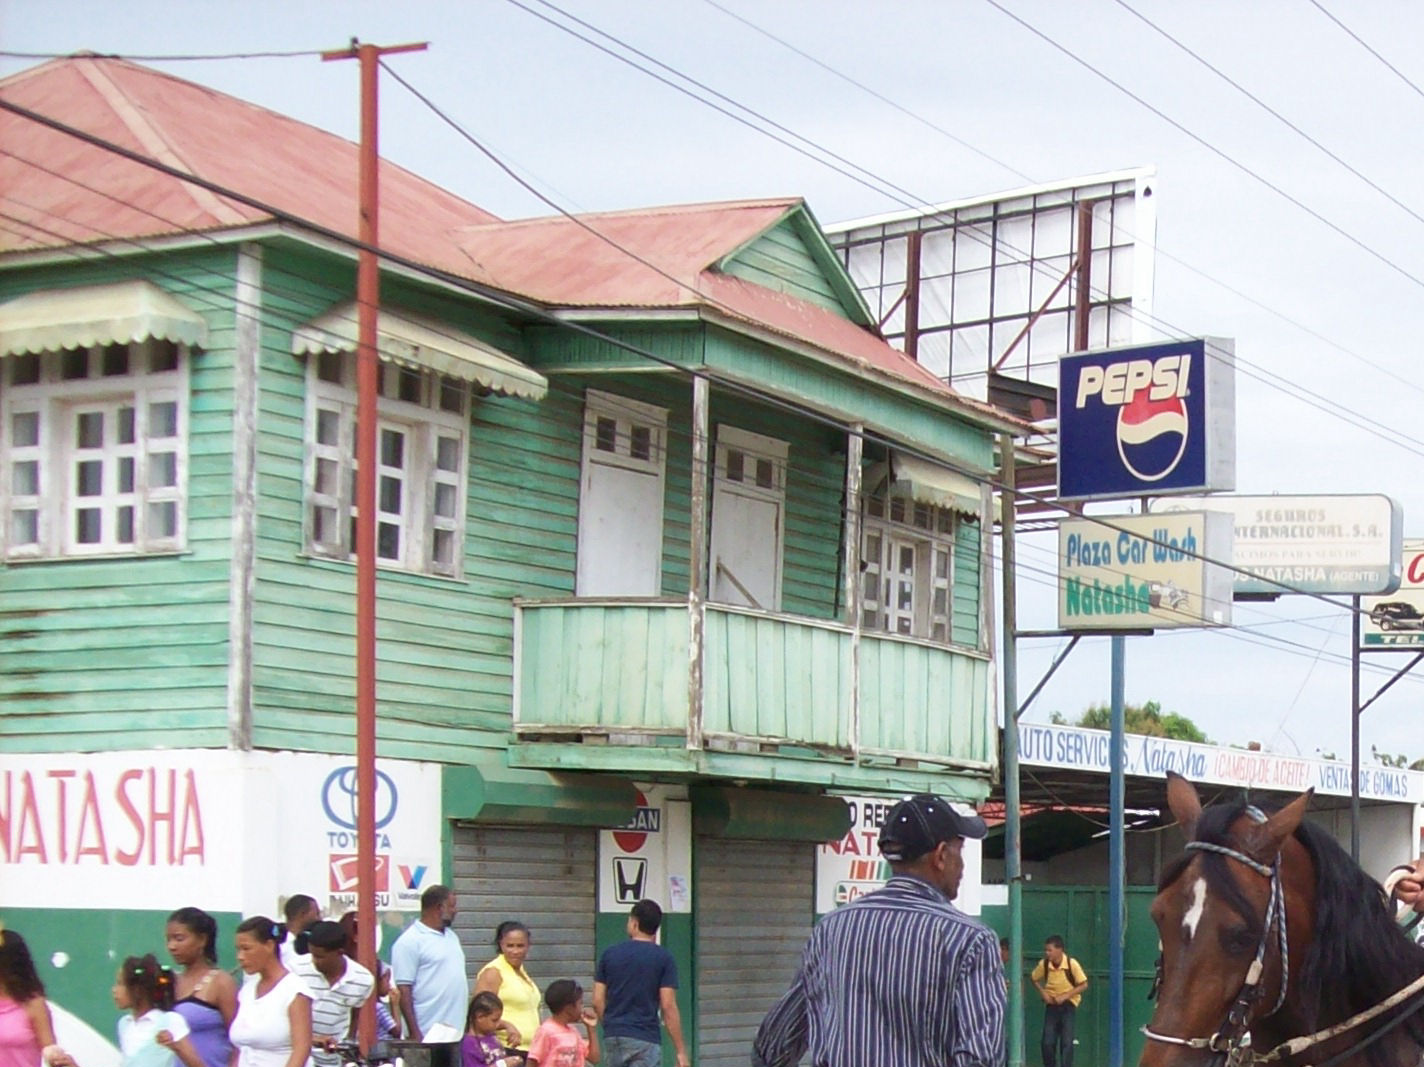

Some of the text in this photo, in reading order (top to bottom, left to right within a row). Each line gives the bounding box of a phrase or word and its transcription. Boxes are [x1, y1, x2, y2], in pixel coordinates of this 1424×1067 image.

[1076, 354, 1191, 408] PEPSI
[1256, 509, 1326, 523] SEGUROS
[1067, 527, 1197, 567] Plaza Car Wash
[1254, 566, 1326, 582] NATASHA
[1066, 574, 1150, 616] Natasha
[1057, 732, 1130, 768] SERVICS
[1133, 736, 1207, 777] Natasha
[1319, 765, 1353, 790] VENTA
[1360, 769, 1370, 793] DE
[1373, 773, 1408, 798] GOMAS
[327, 831, 392, 849] TOYTA
